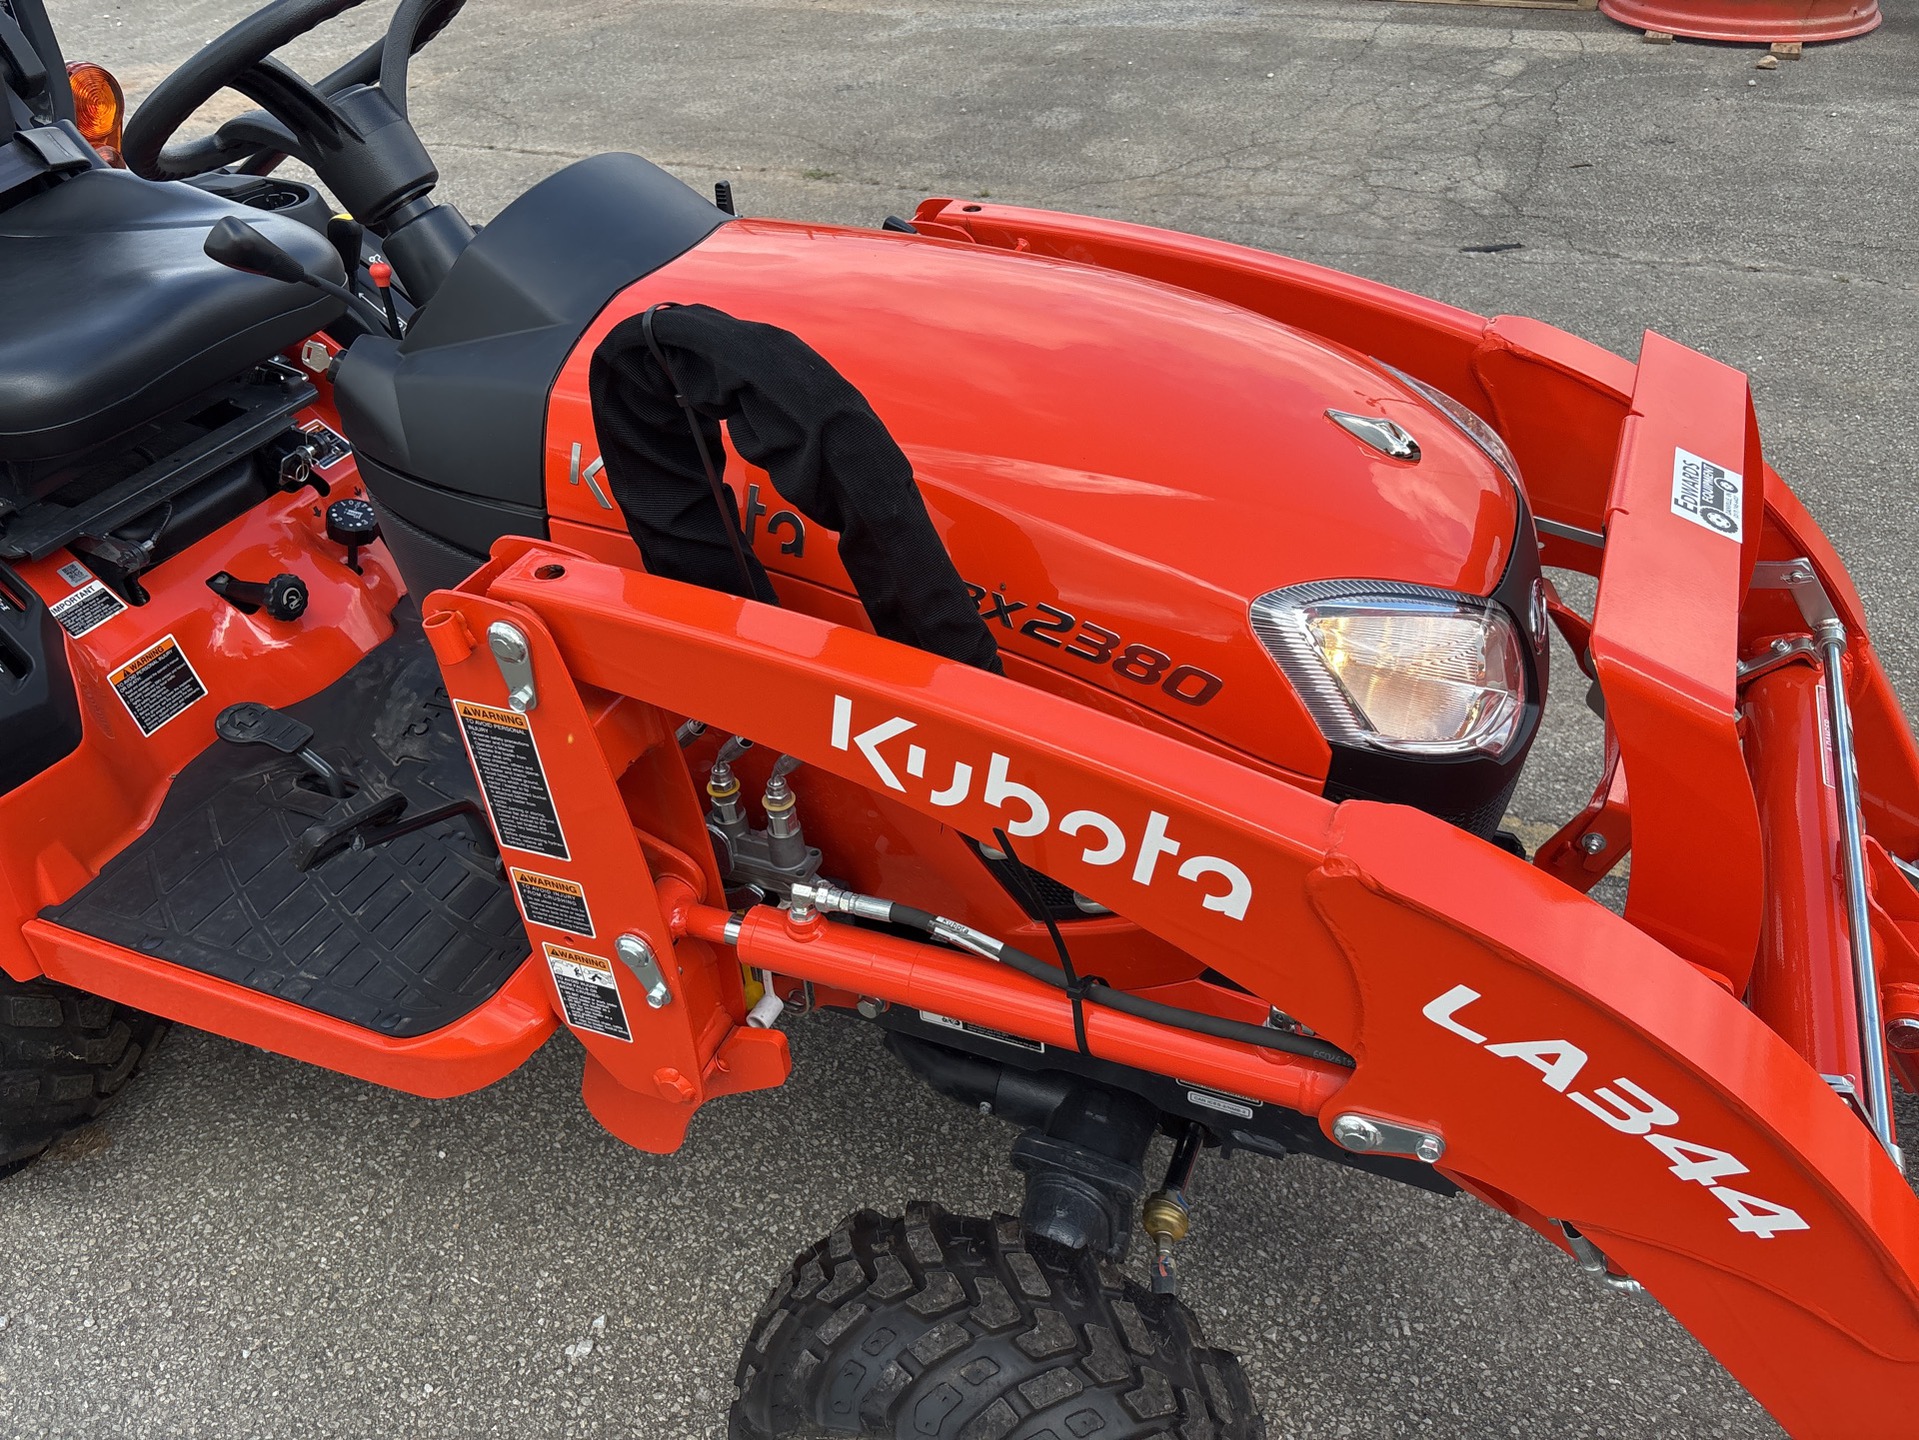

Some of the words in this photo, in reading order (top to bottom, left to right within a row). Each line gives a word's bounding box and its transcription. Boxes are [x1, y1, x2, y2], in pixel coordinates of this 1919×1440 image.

[1674, 459, 1700, 515] EDWARDS
[50, 586, 96, 614] IMPORTANT
[129, 645, 164, 672] WARNING
[470, 708, 524, 726] WARNING
[474, 720, 493, 728] AVOID
[493, 724, 526, 734] PERSONAL
[830, 693, 1254, 922] Kubota
[526, 875, 577, 893] WARNING
[531, 886, 551, 894] AVOID
[552, 891, 575, 900] INJURY
[557, 950, 607, 969] WARNING
[1421, 982, 1812, 1240] LA344
